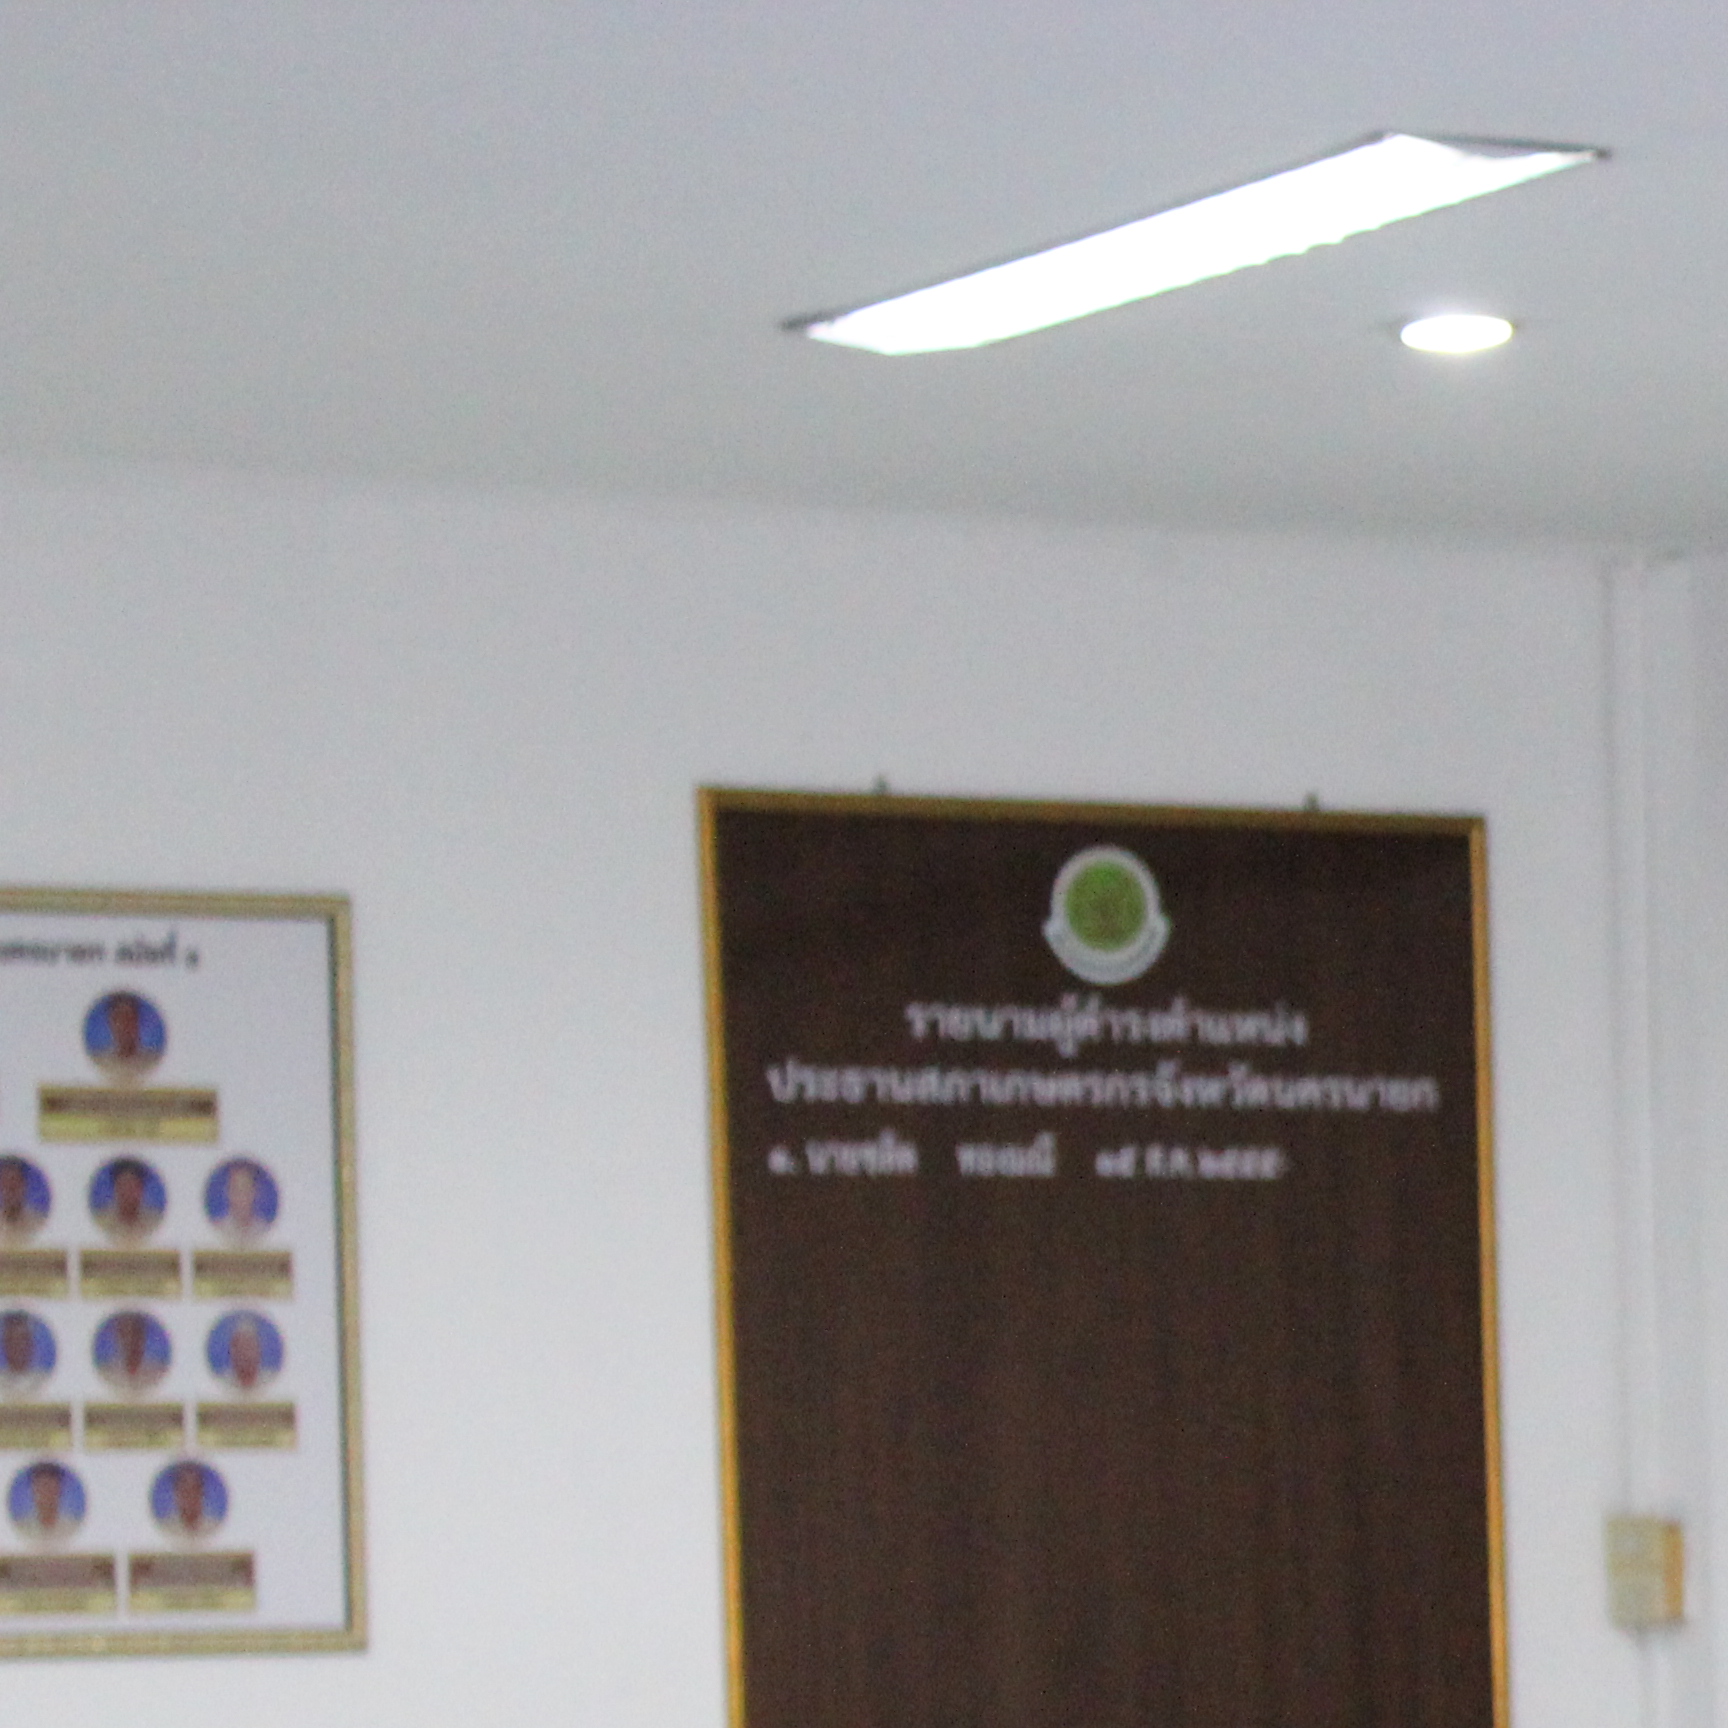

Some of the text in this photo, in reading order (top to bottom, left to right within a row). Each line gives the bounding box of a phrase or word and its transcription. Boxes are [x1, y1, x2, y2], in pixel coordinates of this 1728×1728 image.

[766, 1058, 1440, 1114] ประธานสภาเกษตรกรจังหวัดนครนายก
